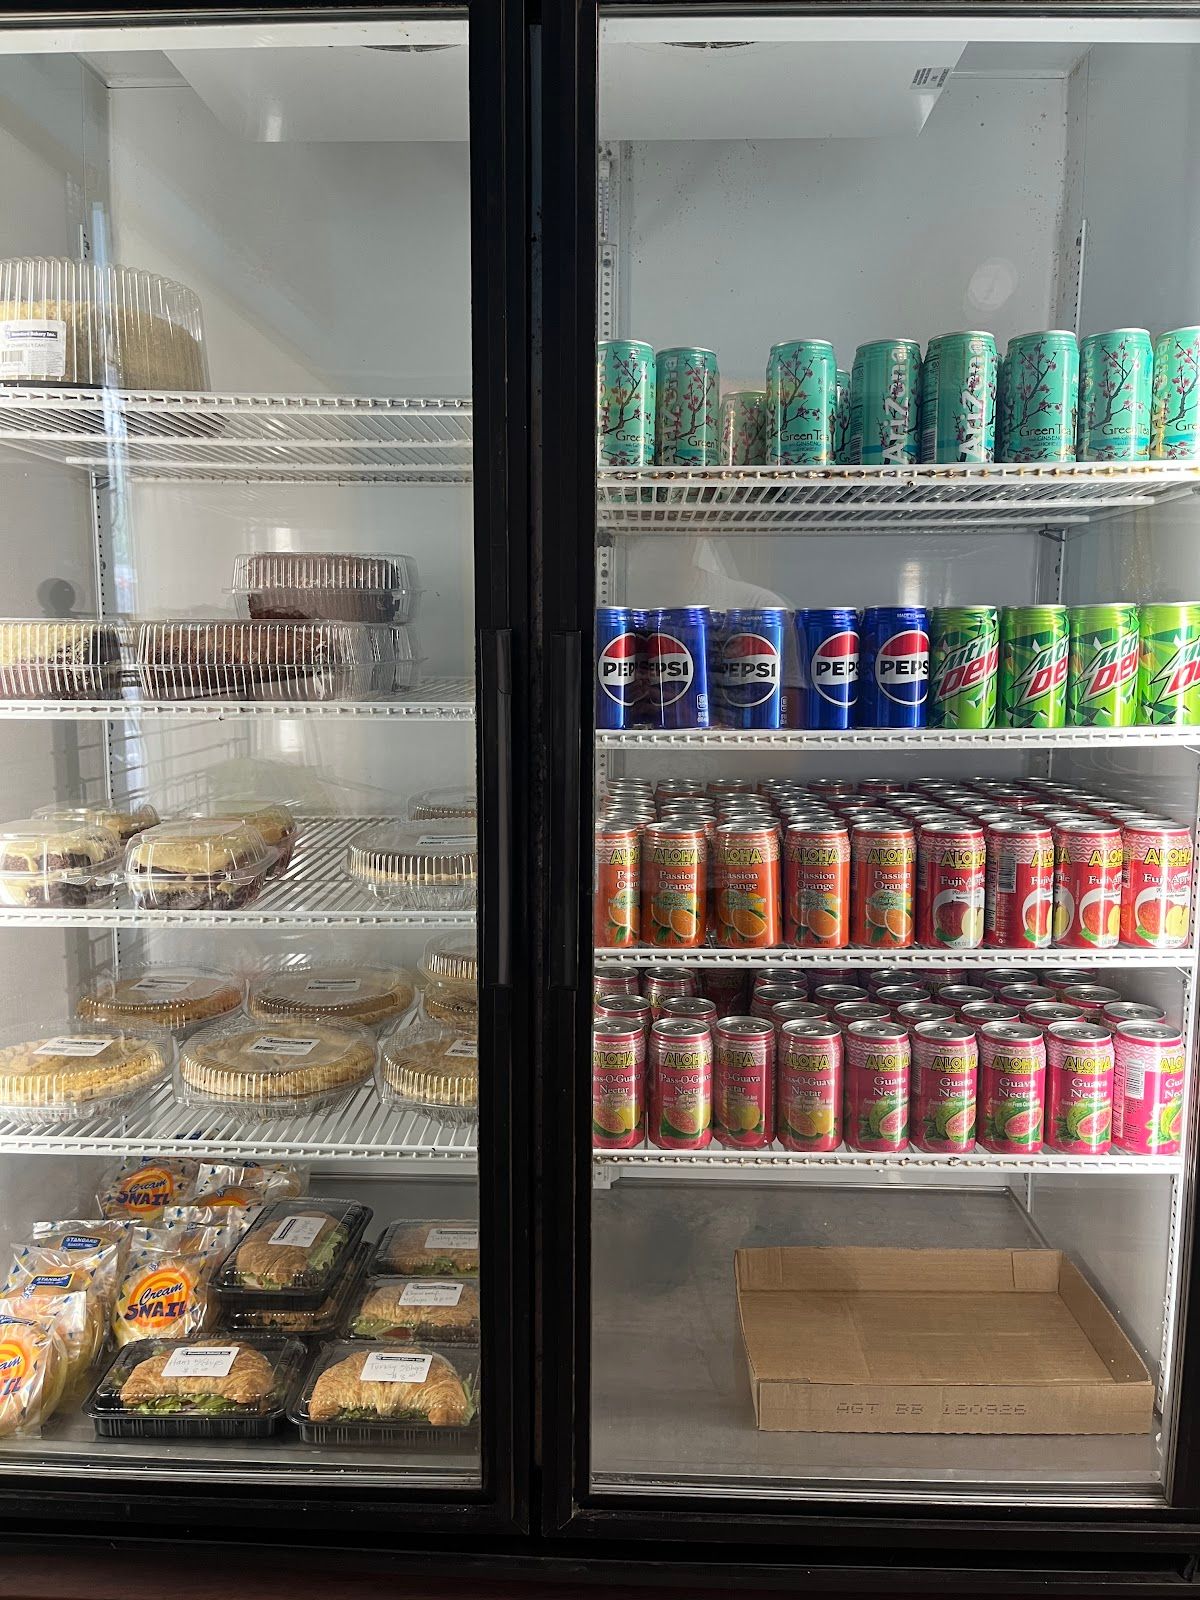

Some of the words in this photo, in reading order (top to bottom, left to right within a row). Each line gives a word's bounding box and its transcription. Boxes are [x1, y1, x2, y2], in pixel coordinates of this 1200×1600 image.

[779, 430, 812, 442] Green
[1019, 424, 1055, 437] Green
[653, 848, 702, 865] ALOHA
[718, 848, 763, 865] ALOHA
[792, 848, 839, 865] ALOHA
[867, 848, 914, 865] ALOHA
[940, 848, 986, 868] ALOHA
[660, 870, 697, 880] Passion
[720, 870, 758, 880] Passion
[797, 870, 836, 880] Passion
[874, 870, 911, 880] Passion
[940, 875, 962, 887] Fuji
[659, 881, 697, 892] Orange
[722, 880, 758, 891] Orange
[796, 880, 835, 891] Orange
[873, 880, 911, 891] Orange
[664, 1052, 710, 1070] ALOHA
[784, 1052, 830, 1071] ALOHA
[865, 1052, 910, 1071] ALOHA
[931, 1054, 977, 1072] ALOHA
[992, 1055, 1040, 1072] ALOHA
[1063, 1055, 1111, 1072] ALOHA
[873, 1076, 906, 1086] Guava
[940, 1077, 973, 1087] Guava
[1000, 1077, 1036, 1087] Guava
[1071, 1078, 1108, 1088] Guava
[600, 1084, 630, 1096] Nectar
[791, 1085, 822, 1098] Nectar
[872, 1087, 906, 1097] Nectar
[939, 1088, 974, 1098] Nectar
[998, 1087, 1037, 1098] Nectar
[1070, 1088, 1107, 1098] Nectar
[129, 1179, 168, 1193] Cream
[116, 1191, 170, 1206] SNAIL
[139, 1283, 184, 1305] Cream
[124, 1301, 187, 1321] SNAIL
